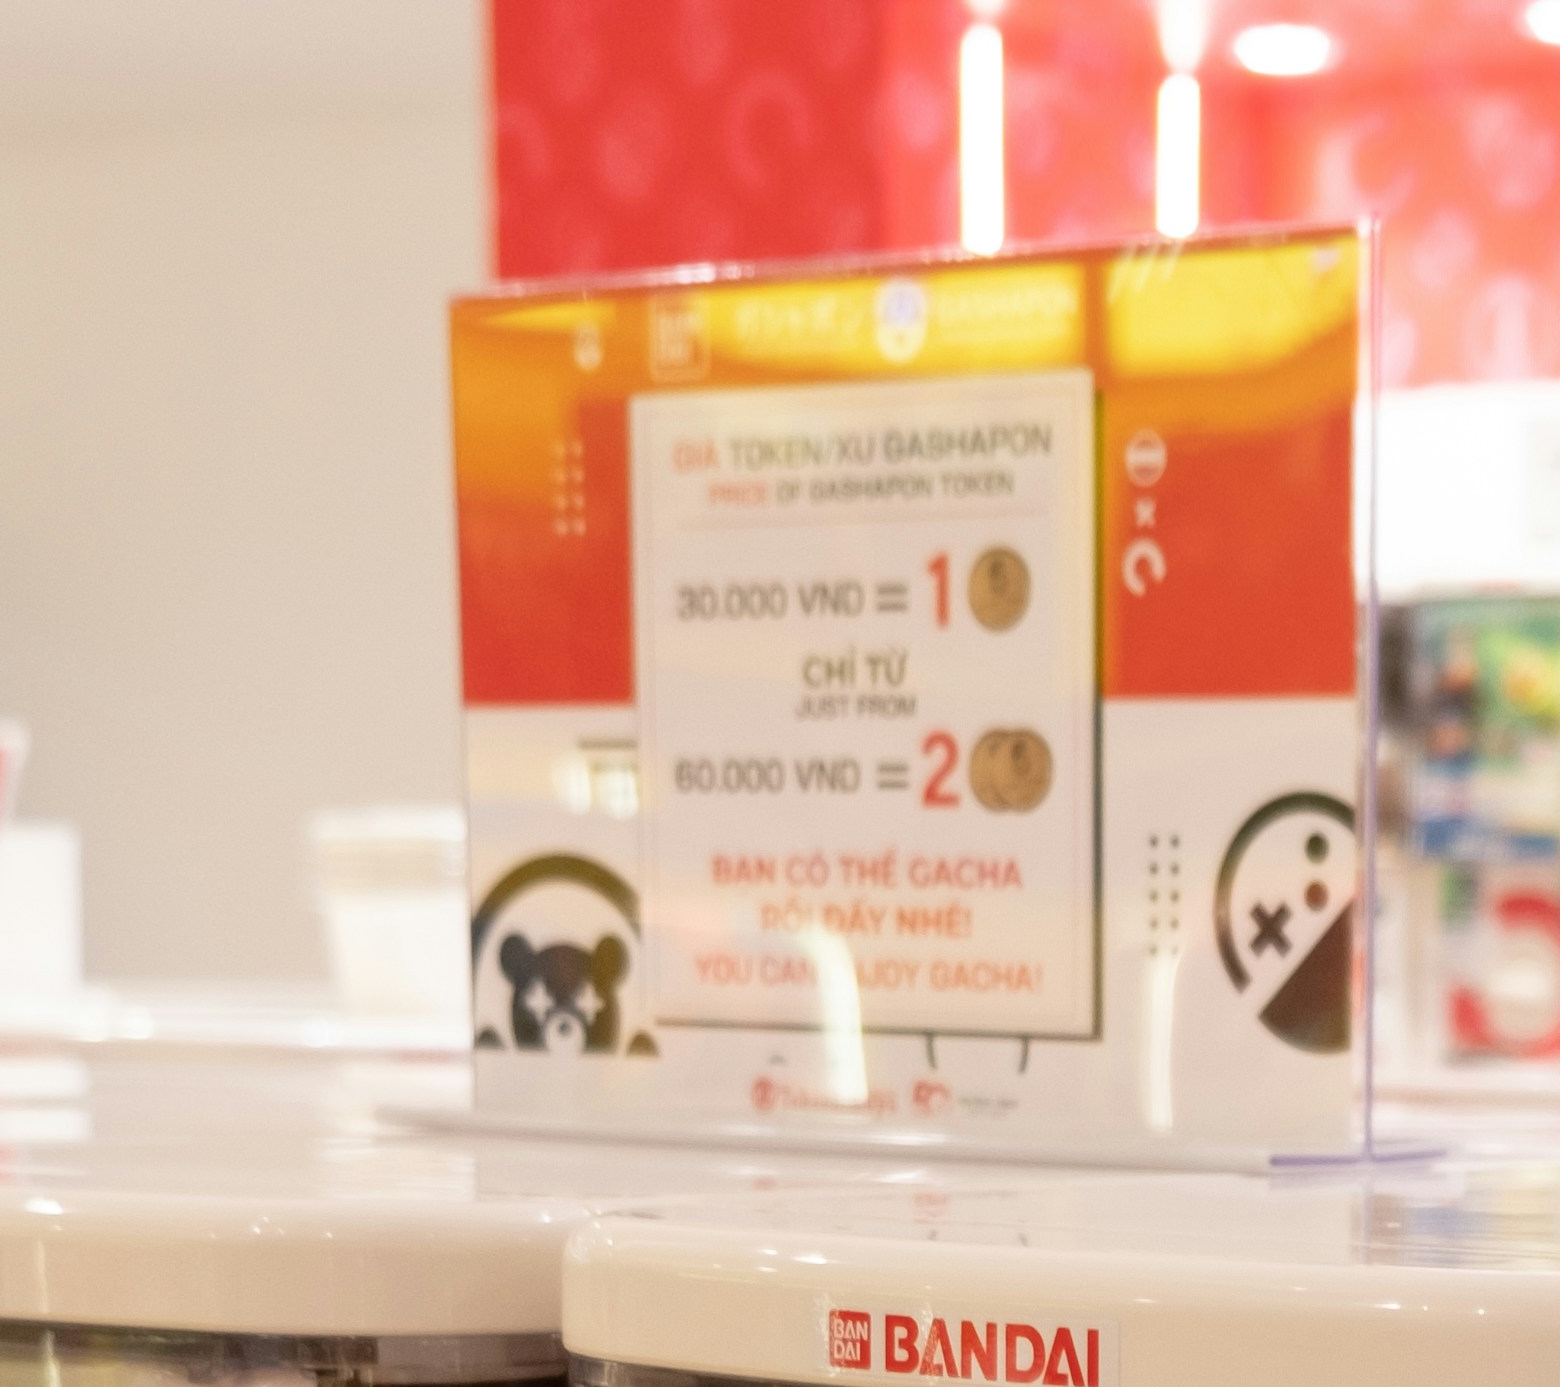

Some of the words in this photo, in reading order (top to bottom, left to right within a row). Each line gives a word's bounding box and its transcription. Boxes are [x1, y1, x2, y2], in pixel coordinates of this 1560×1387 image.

[882, 423, 1053, 464] GASHAPON
[808, 474, 935, 504] GASHAPON
[940, 471, 1015, 499] TOKEN
[675, 584, 790, 620] 30.000
[798, 581, 866, 617] VND
[926, 551, 953, 630] 1
[849, 690, 917, 718] FROM
[674, 759, 788, 796] 60.000
[798, 758, 862, 792] VND
[920, 729, 959, 809] 2
[908, 854, 1022, 889] GACHA
[694, 952, 751, 986] YOU
